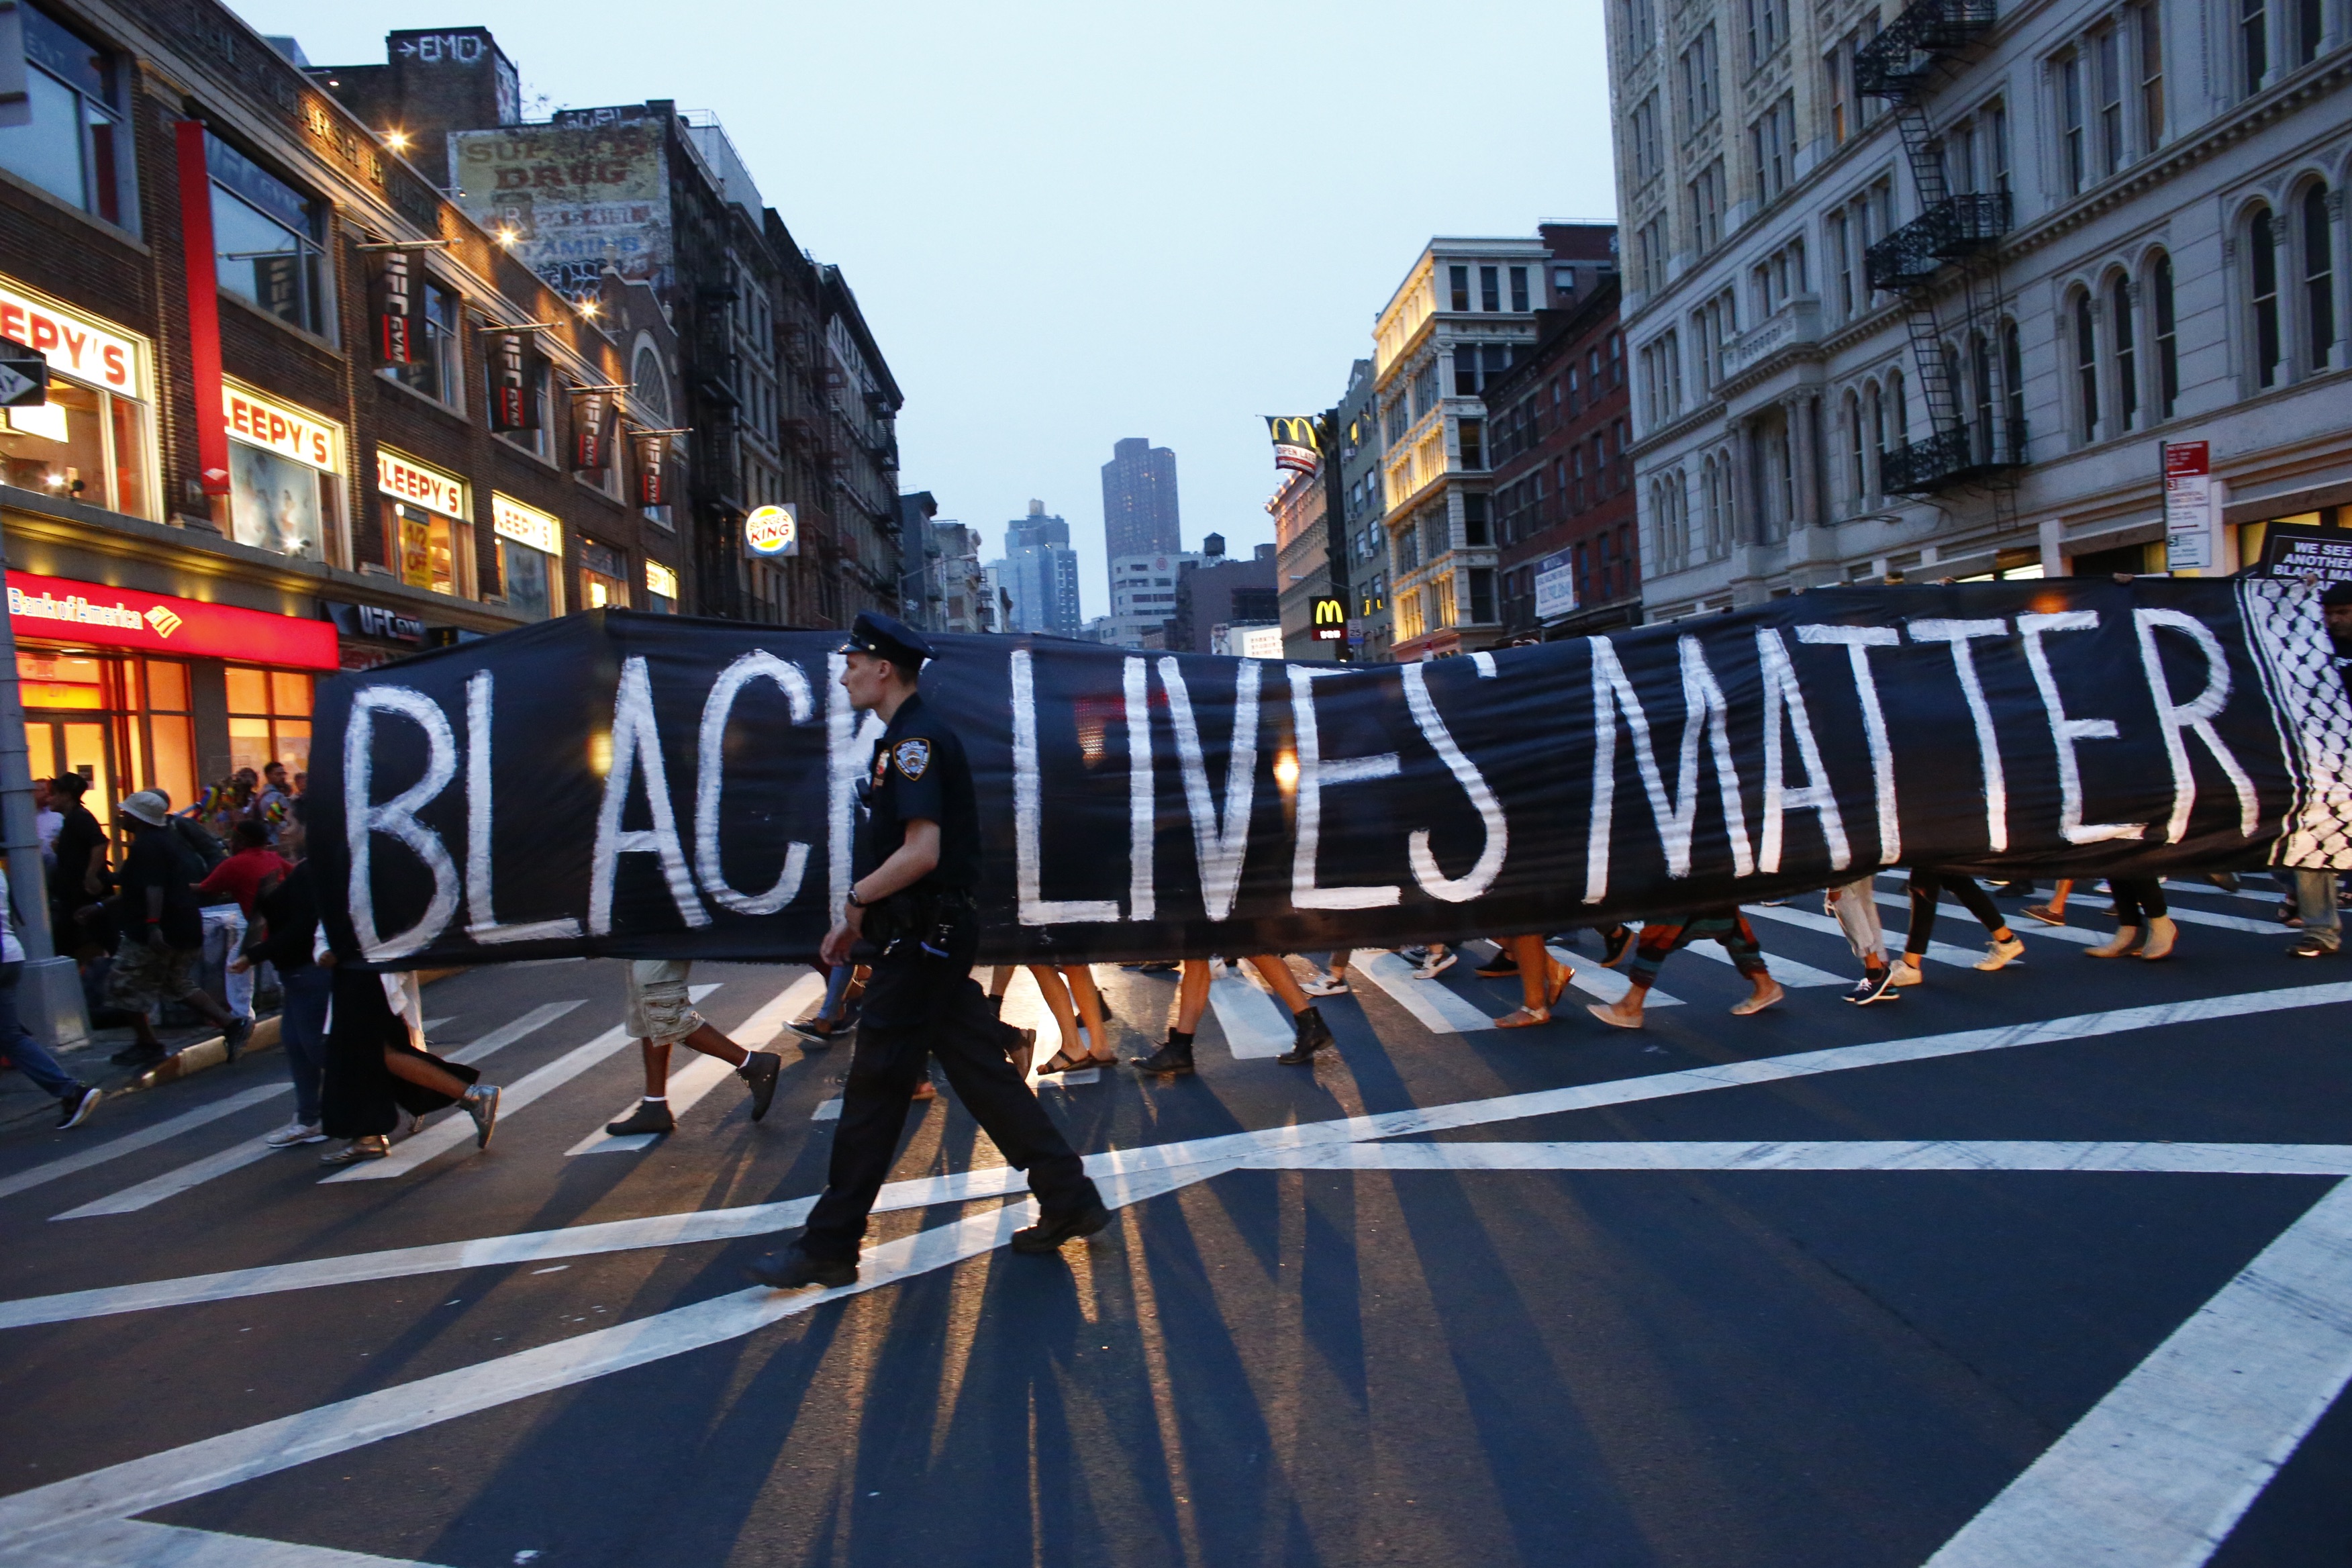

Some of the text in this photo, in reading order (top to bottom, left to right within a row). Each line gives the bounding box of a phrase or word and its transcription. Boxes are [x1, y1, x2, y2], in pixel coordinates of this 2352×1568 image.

[385, 252, 409, 315] UFC
[750, 524, 789, 544] KING
[2294, 542, 2352, 557] WE SEE
[7, 587, 144, 630] Bank of America
[358, 603, 397, 638] UFC
[1010, 648, 1508, 925] LIVES
[1581, 607, 2259, 905] MATTER
